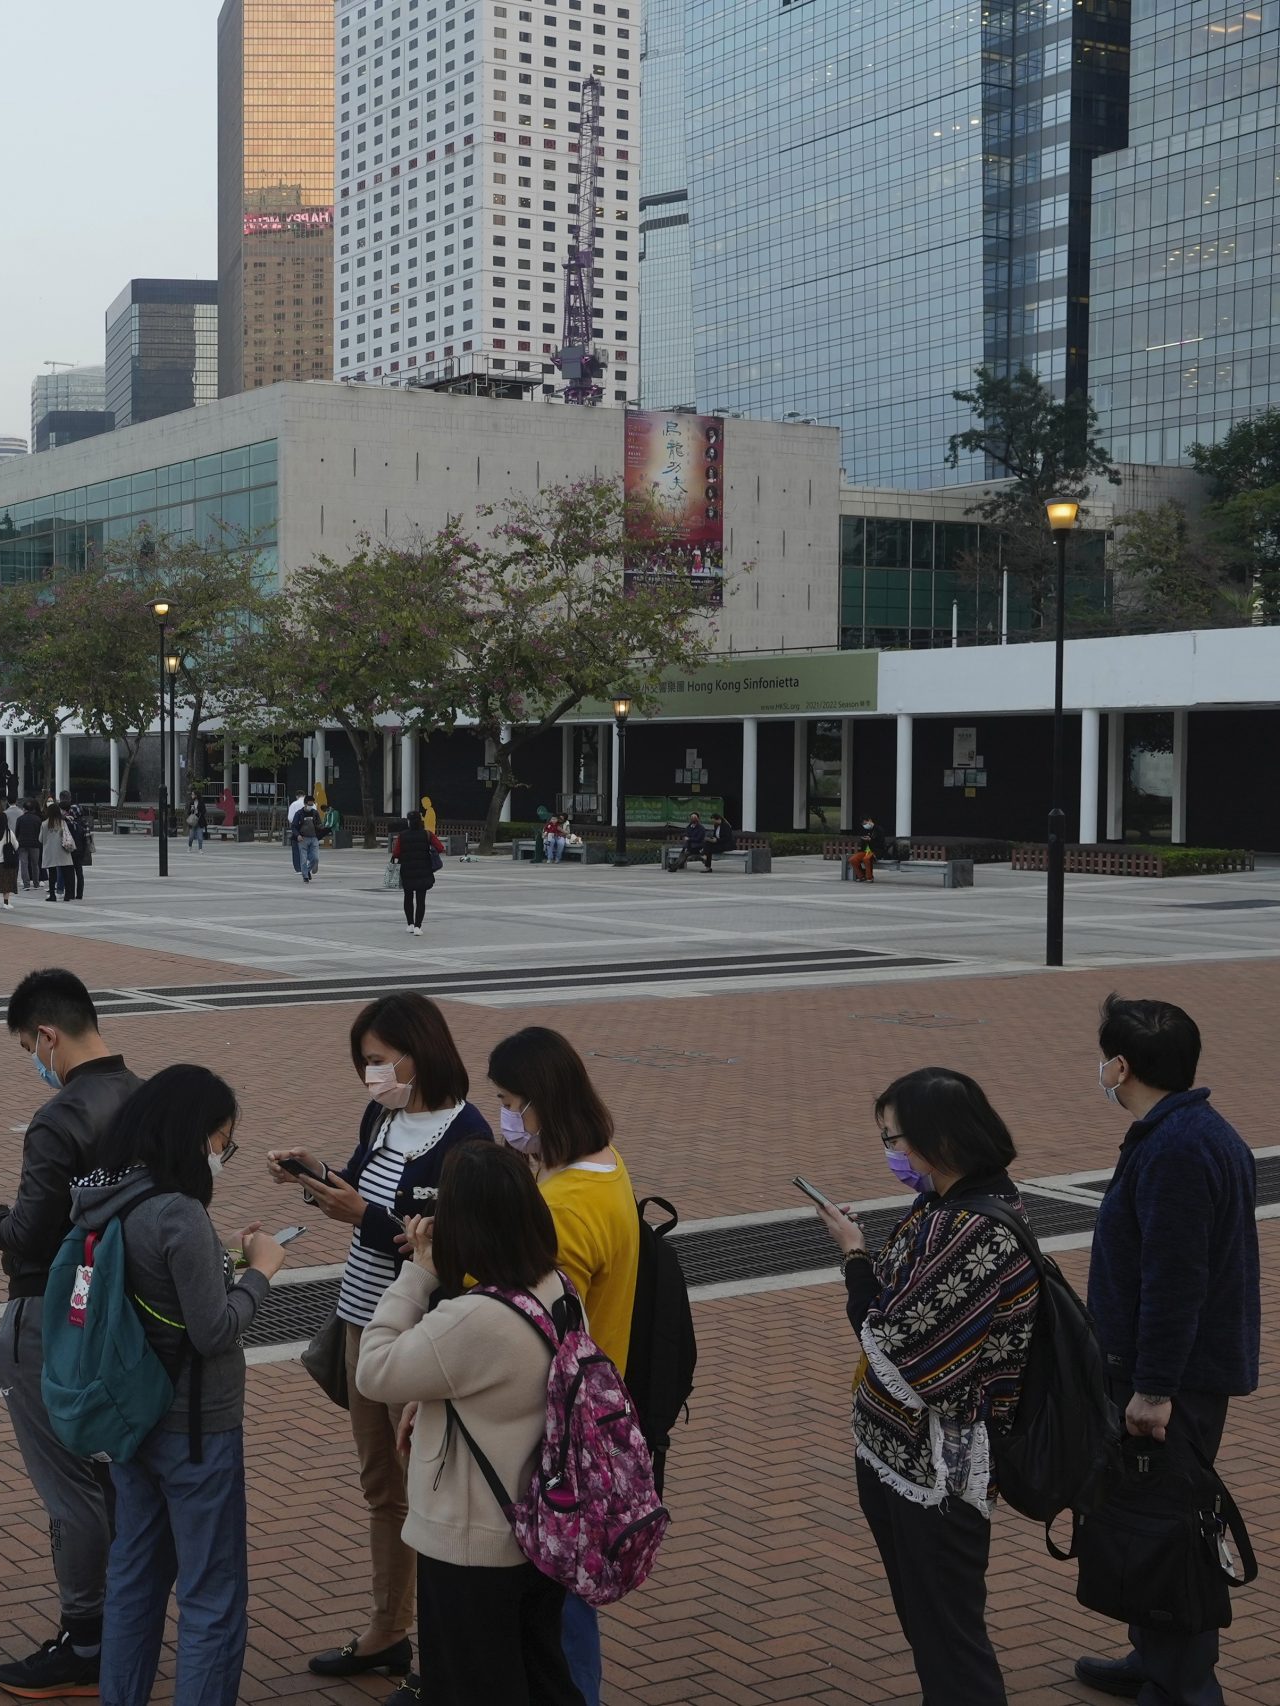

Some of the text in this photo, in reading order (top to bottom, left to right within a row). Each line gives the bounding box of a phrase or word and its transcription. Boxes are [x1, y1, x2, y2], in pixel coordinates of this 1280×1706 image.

[687, 681, 713, 695] Hong
[715, 680, 741, 693] Kong
[743, 676, 799, 690] Sinfonietta
[837, 701, 859, 709] Season
